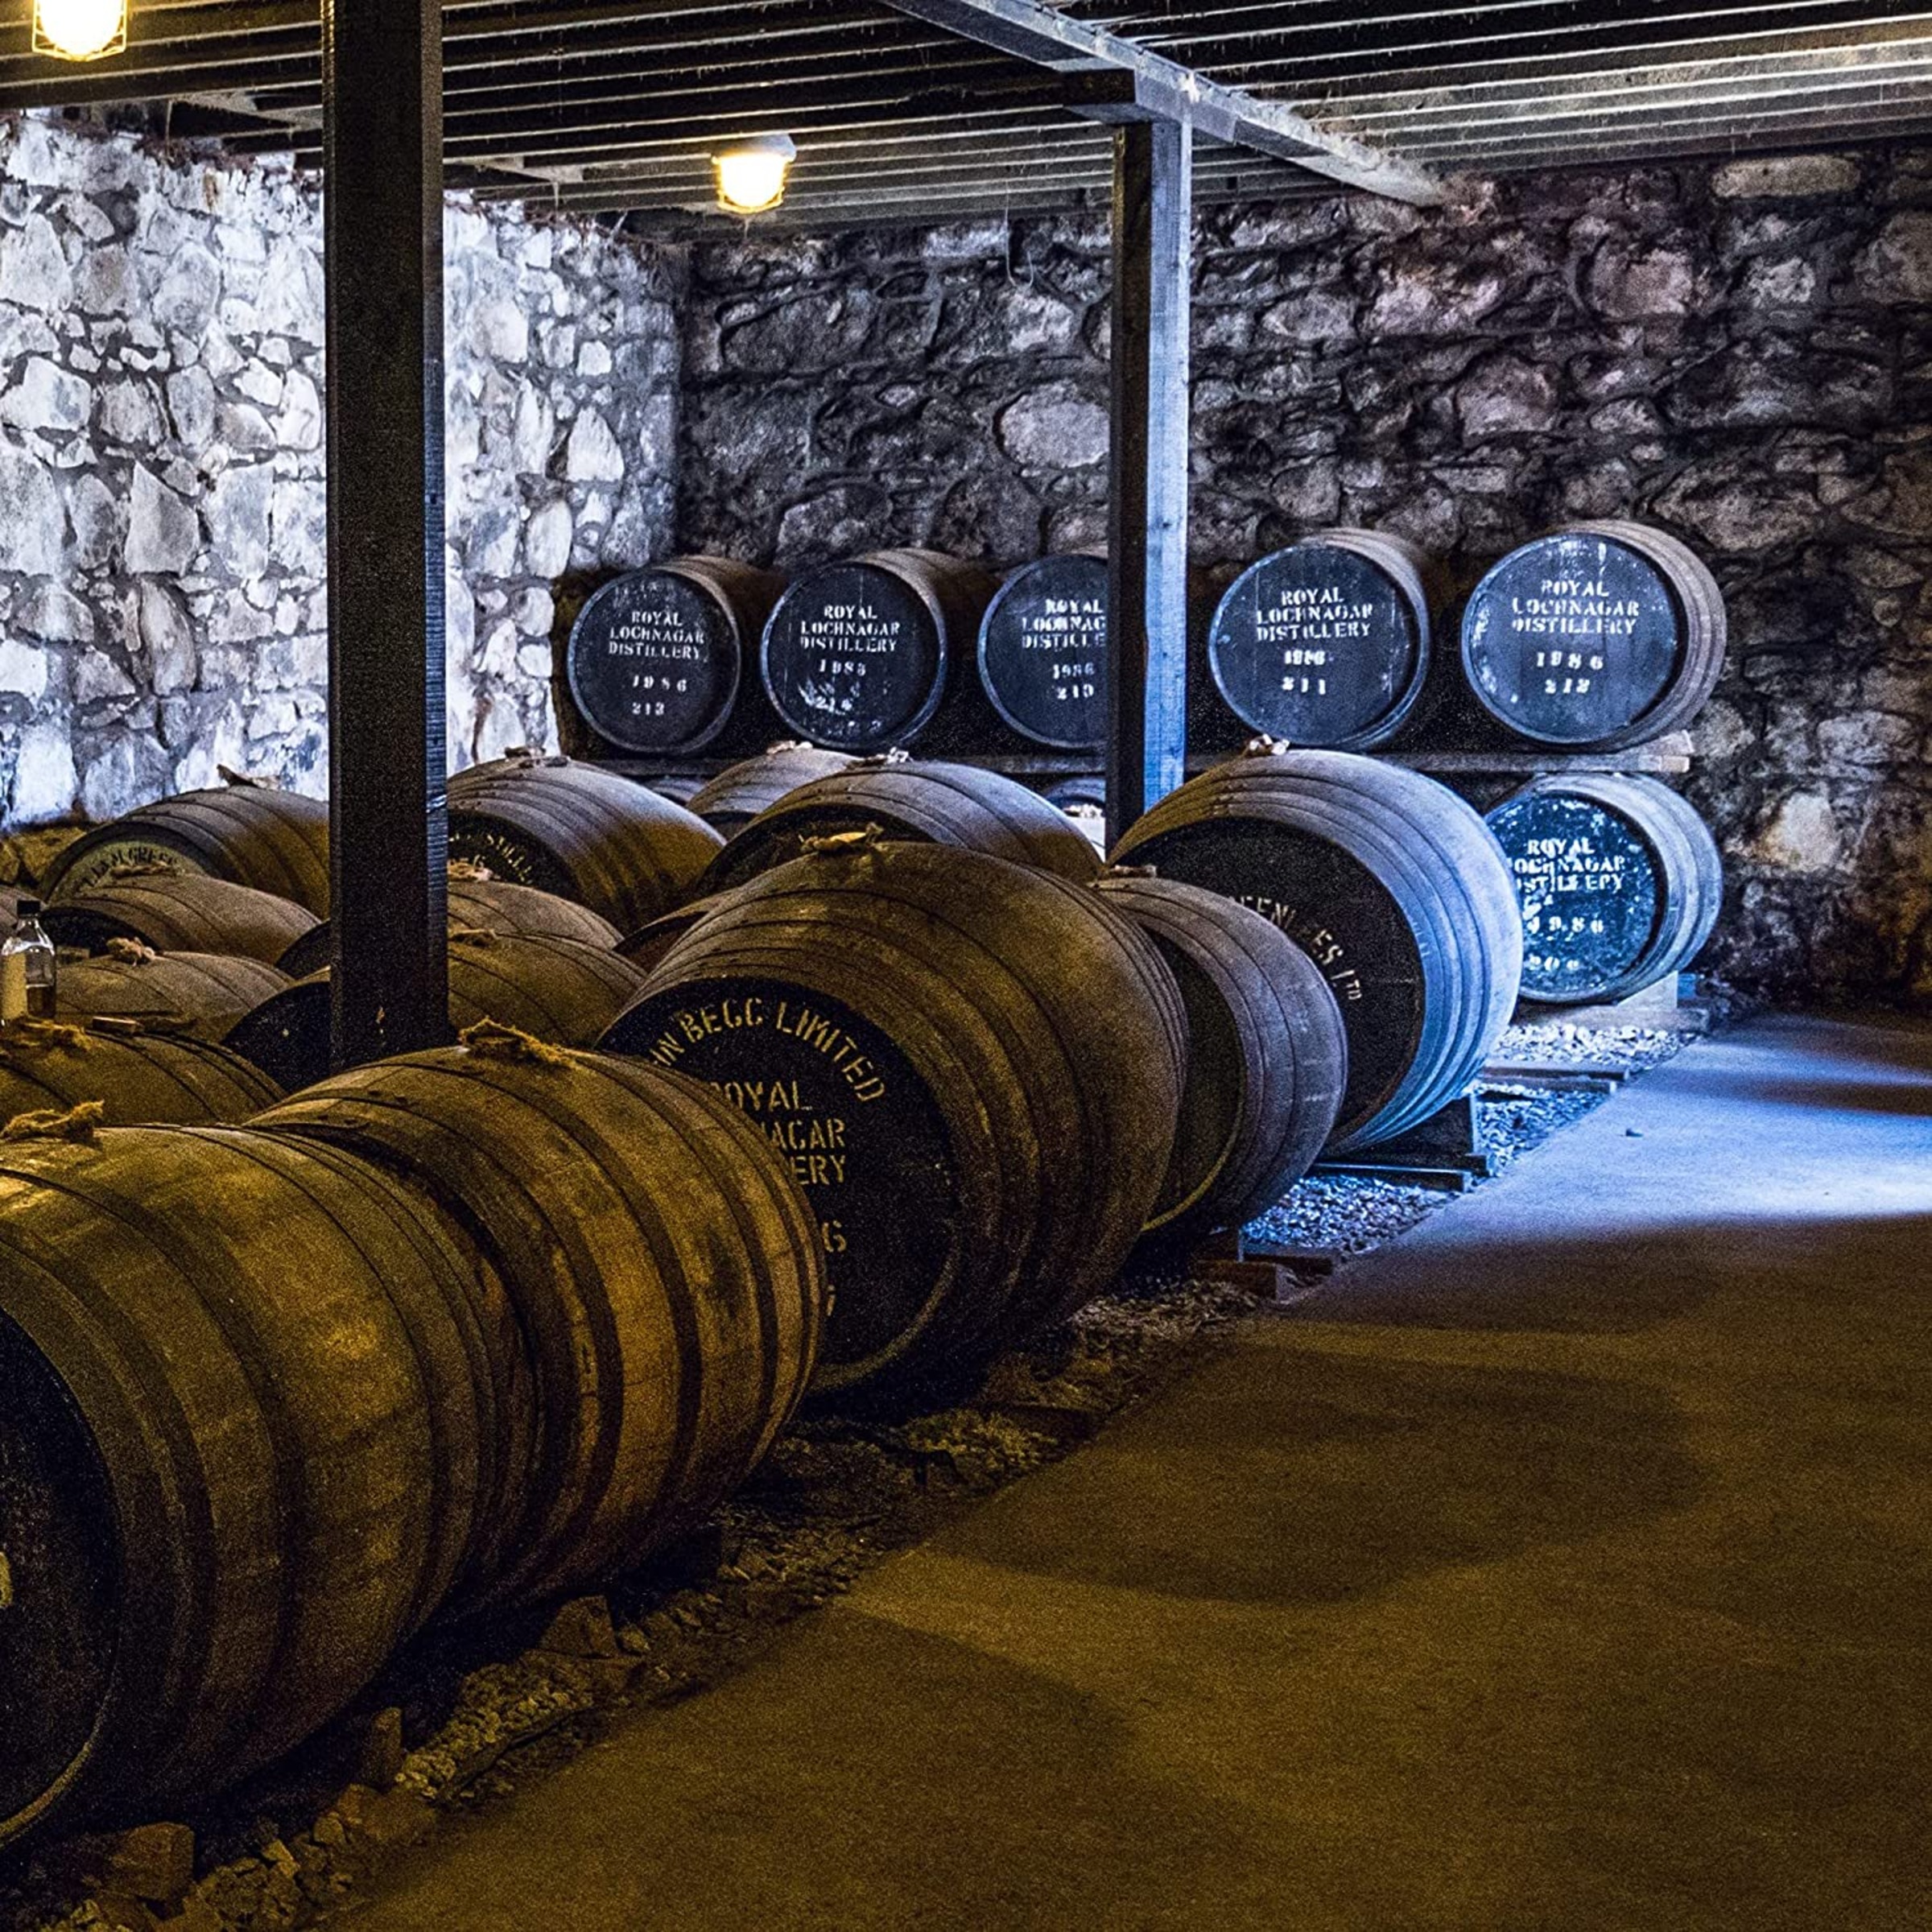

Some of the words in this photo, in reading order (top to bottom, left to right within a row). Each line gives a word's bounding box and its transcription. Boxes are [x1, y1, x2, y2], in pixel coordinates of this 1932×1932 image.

[1282, 588, 1344, 605] ROYAL
[1542, 580, 1609, 597] ROYAL
[824, 605, 877, 620] ROYAL
[1045, 599, 1104, 614] ROYAL
[1257, 603, 1373, 625] LOCHNAGAR
[1512, 597, 1640, 617] LOCHNAGAR
[632, 611, 683, 627] ROYAL
[1512, 617, 1637, 634] DISTILLERY
[609, 626, 705, 644] LOCHNAGAR
[800, 621, 901, 637] LOCHNAGAR
[1257, 621, 1371, 642] DISTILLERY
[609, 642, 700, 659] DISTILLERY
[800, 636, 898, 652] DISTILLERY
[1537, 651, 1604, 670] 1986
[1528, 837, 1596, 857] ROYAL
[1511, 856, 1625, 874] OCHNAGAR
[775, 1001, 886, 1103] LIMITED
[761, 1118, 847, 1150] AGAR
